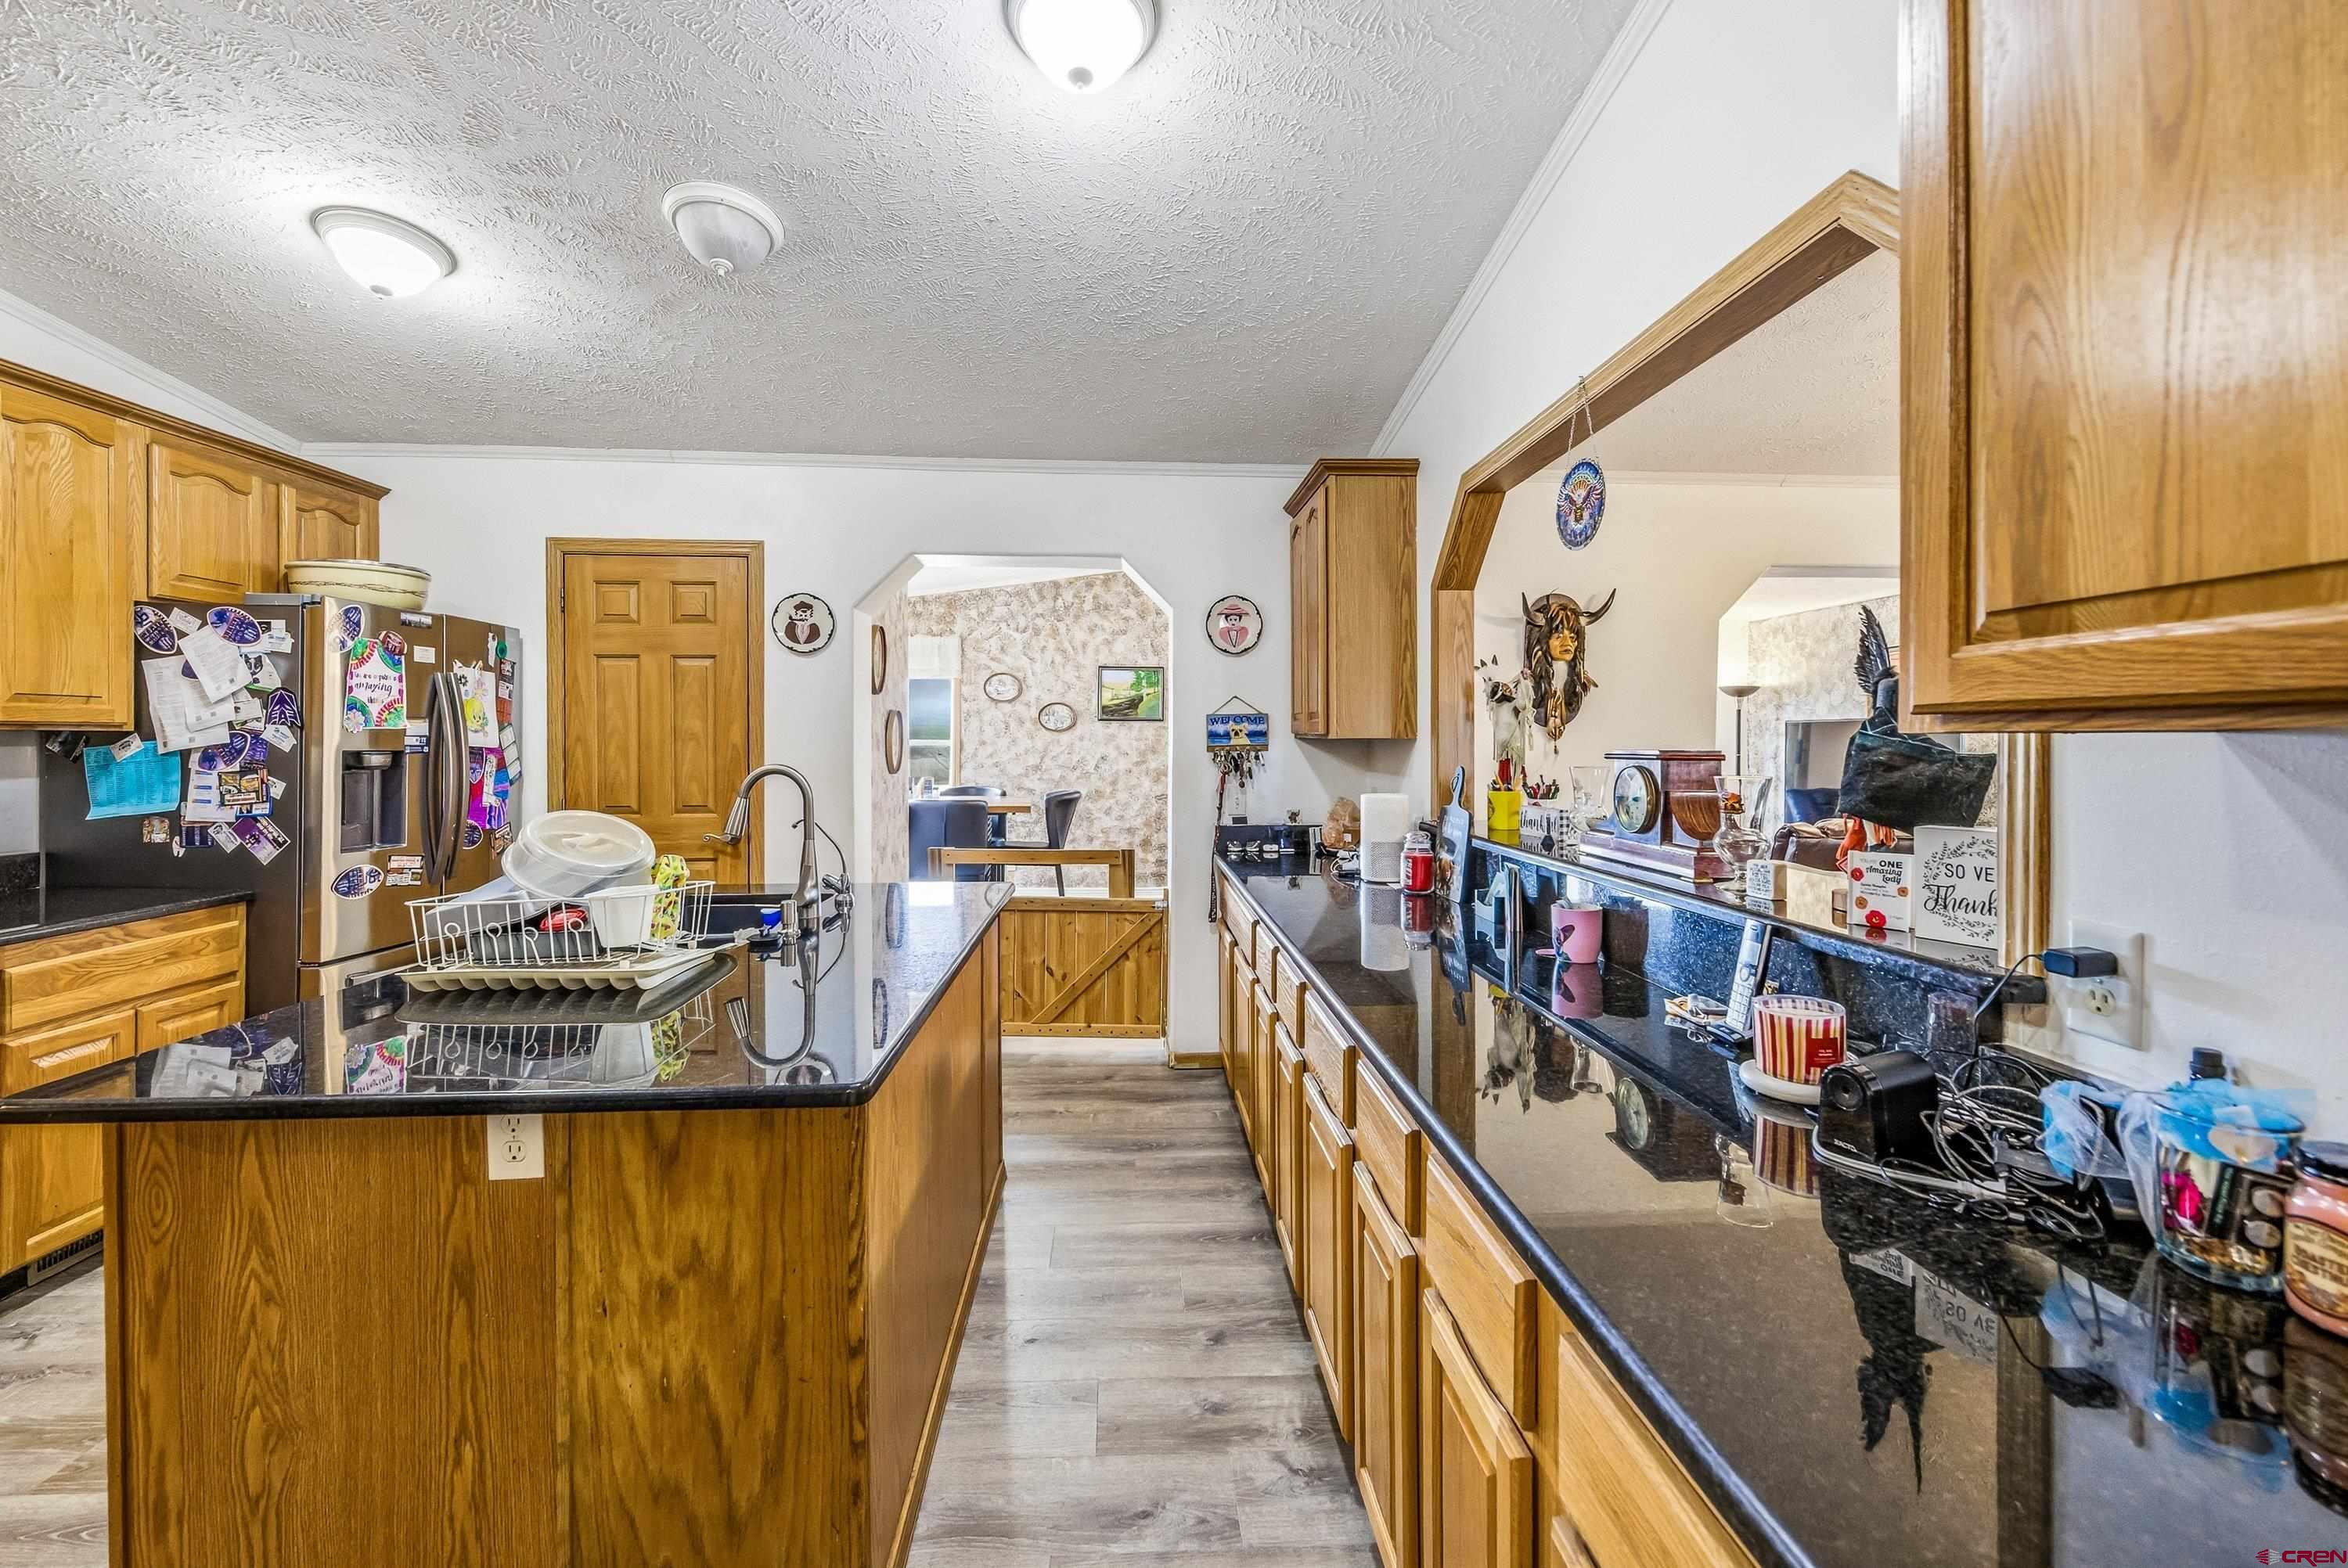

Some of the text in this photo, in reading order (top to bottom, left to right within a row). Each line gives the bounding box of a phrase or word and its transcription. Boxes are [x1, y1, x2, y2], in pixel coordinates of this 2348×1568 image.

[1210, 715, 1266, 725] WELCOME
[1878, 860, 1903, 869] ONE
[1944, 863, 1965, 879] SO
